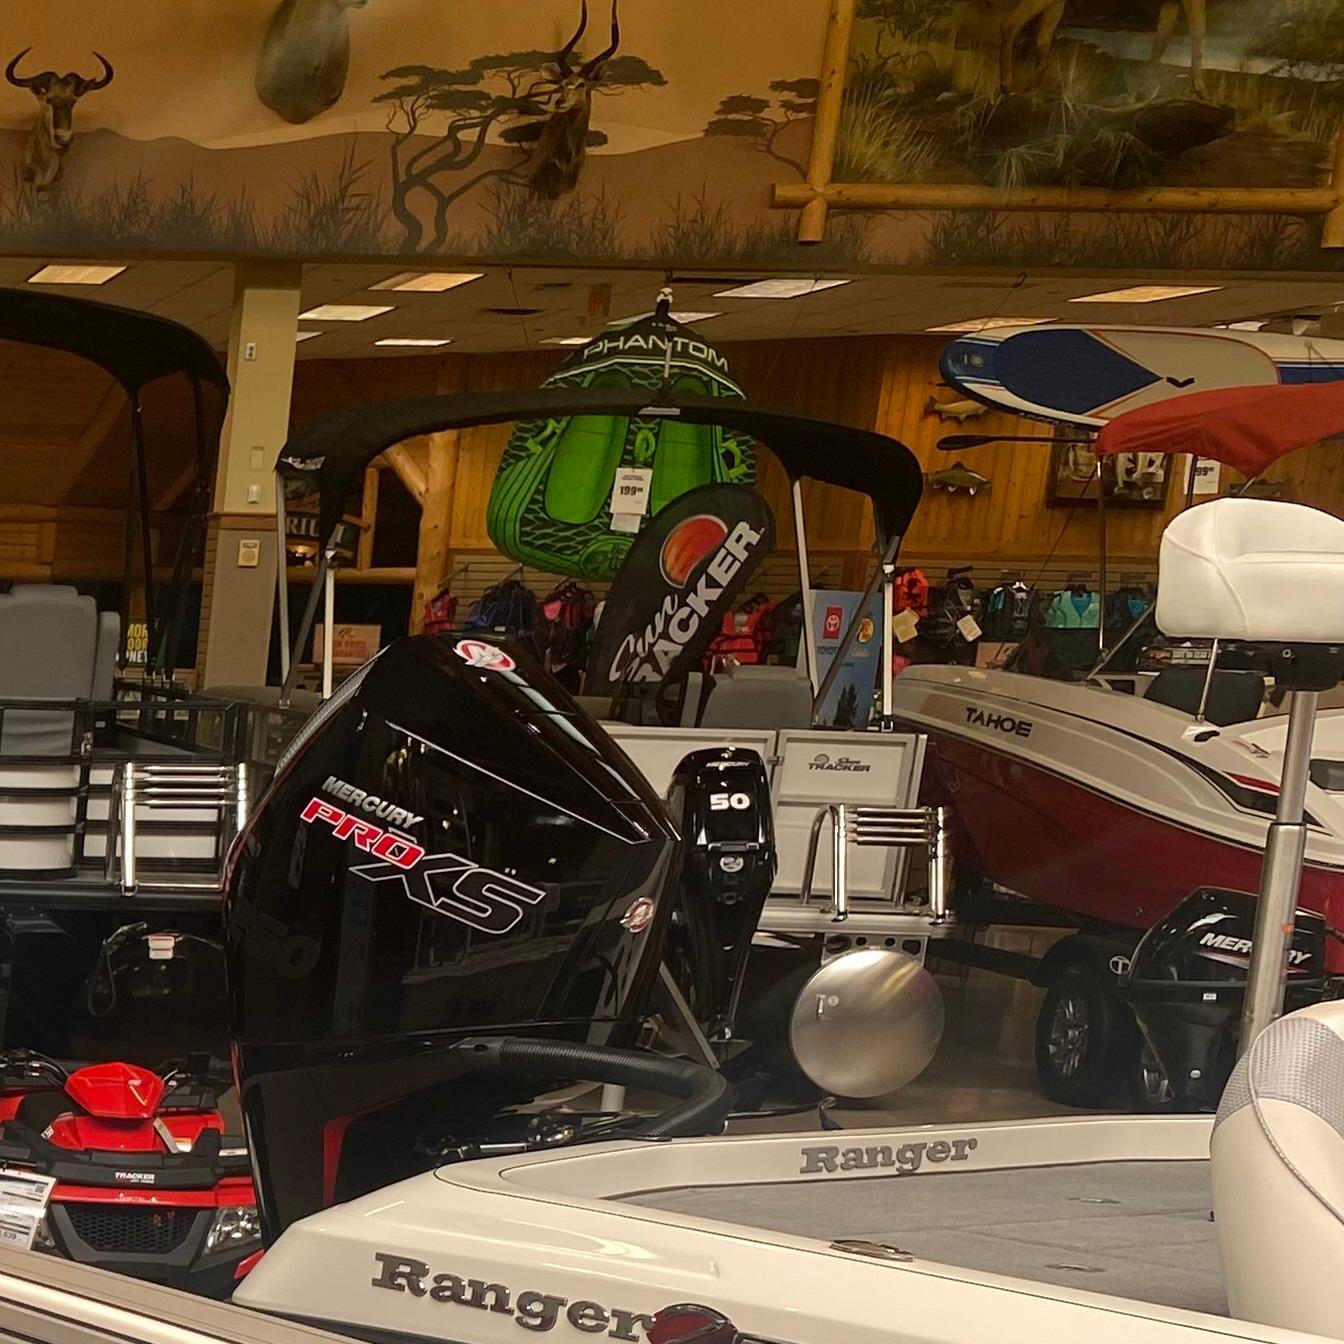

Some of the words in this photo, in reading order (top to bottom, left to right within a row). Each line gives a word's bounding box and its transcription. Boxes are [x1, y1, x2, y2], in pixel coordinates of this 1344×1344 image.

[583, 334, 729, 373] PHANTOM
[628, 520, 762, 682] RACKER
[965, 706, 1033, 738] TAHOE
[808, 762, 871, 772] TRACKER
[321, 775, 424, 829] MERCURY
[710, 792, 751, 811] 50
[300, 797, 425, 870] PRO
[348, 828, 546, 935] XS
[799, 1137, 978, 1175] Ranger
[115, 1172, 155, 1180] TRACKER
[371, 1251, 655, 1342] Ranger
